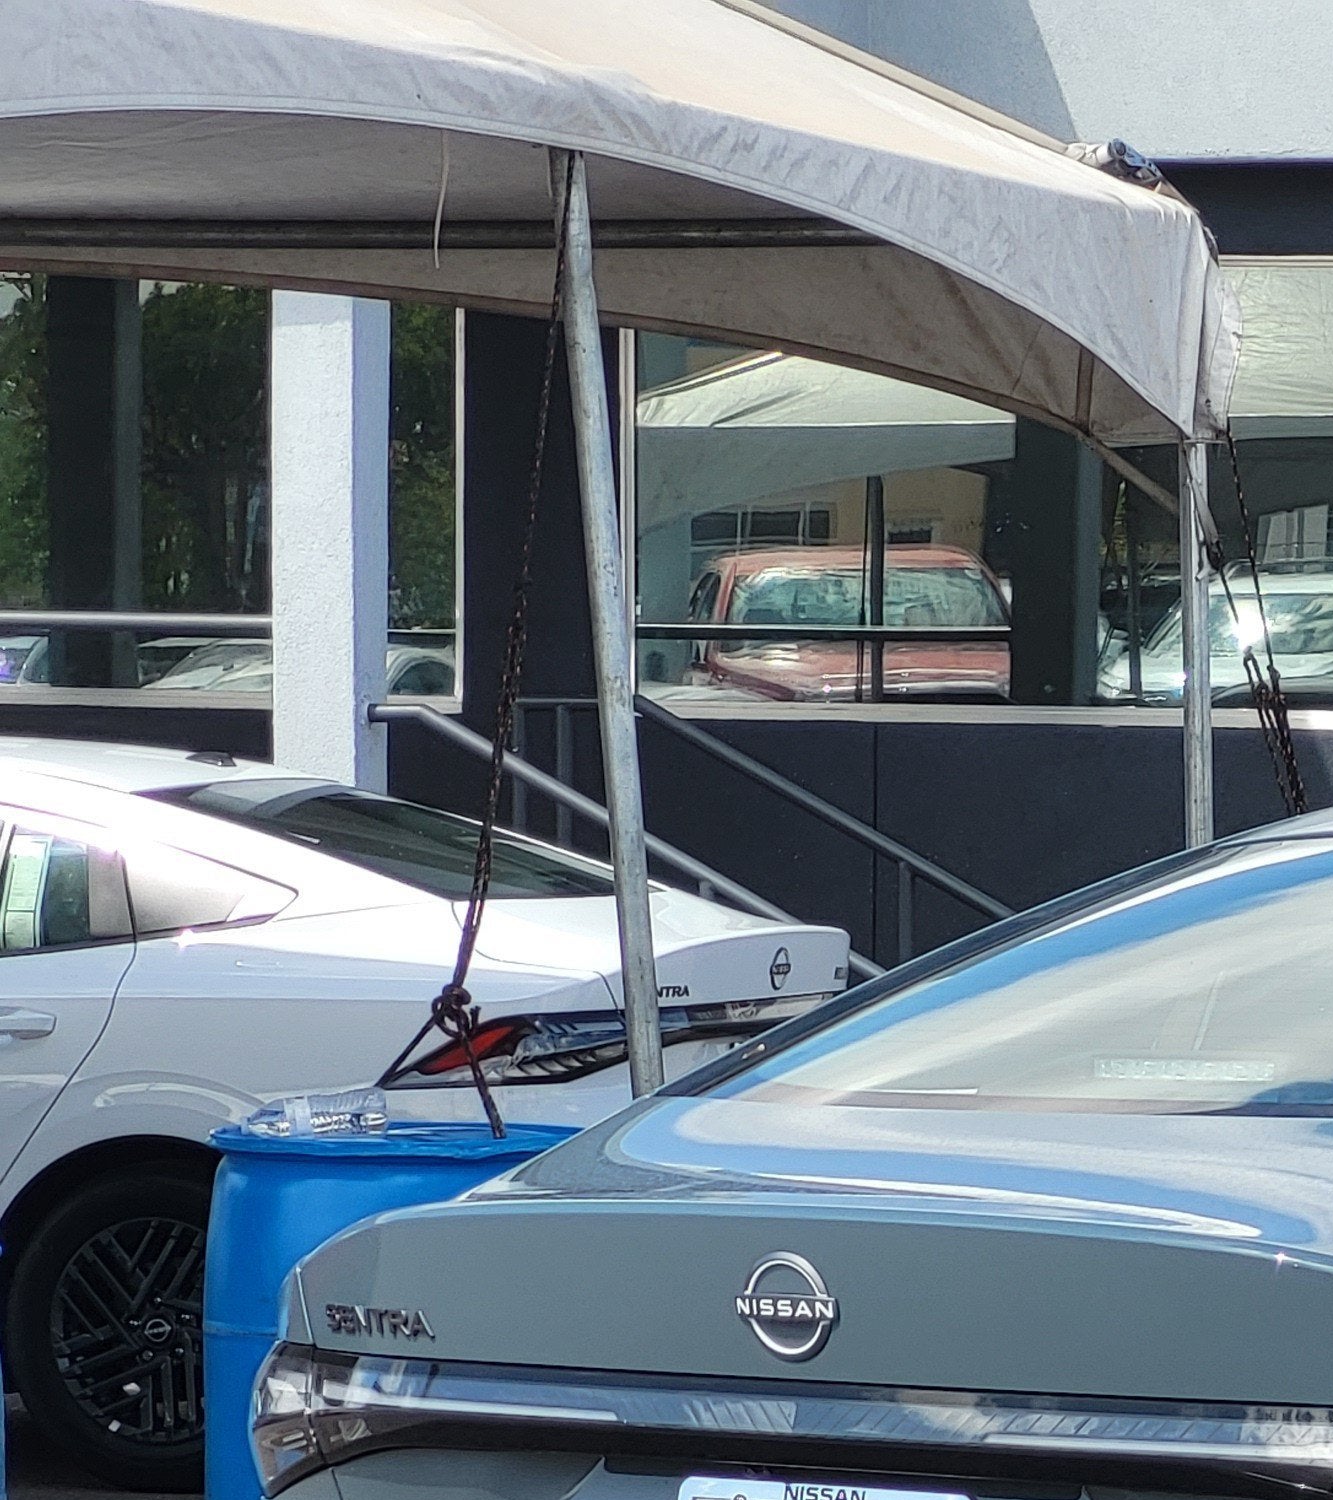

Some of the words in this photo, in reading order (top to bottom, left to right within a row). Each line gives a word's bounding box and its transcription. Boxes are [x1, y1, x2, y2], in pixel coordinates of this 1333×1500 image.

[655, 985, 690, 998] NTRA
[735, 1297, 835, 1319] NISSAN
[324, 1303, 436, 1342] SENTRA
